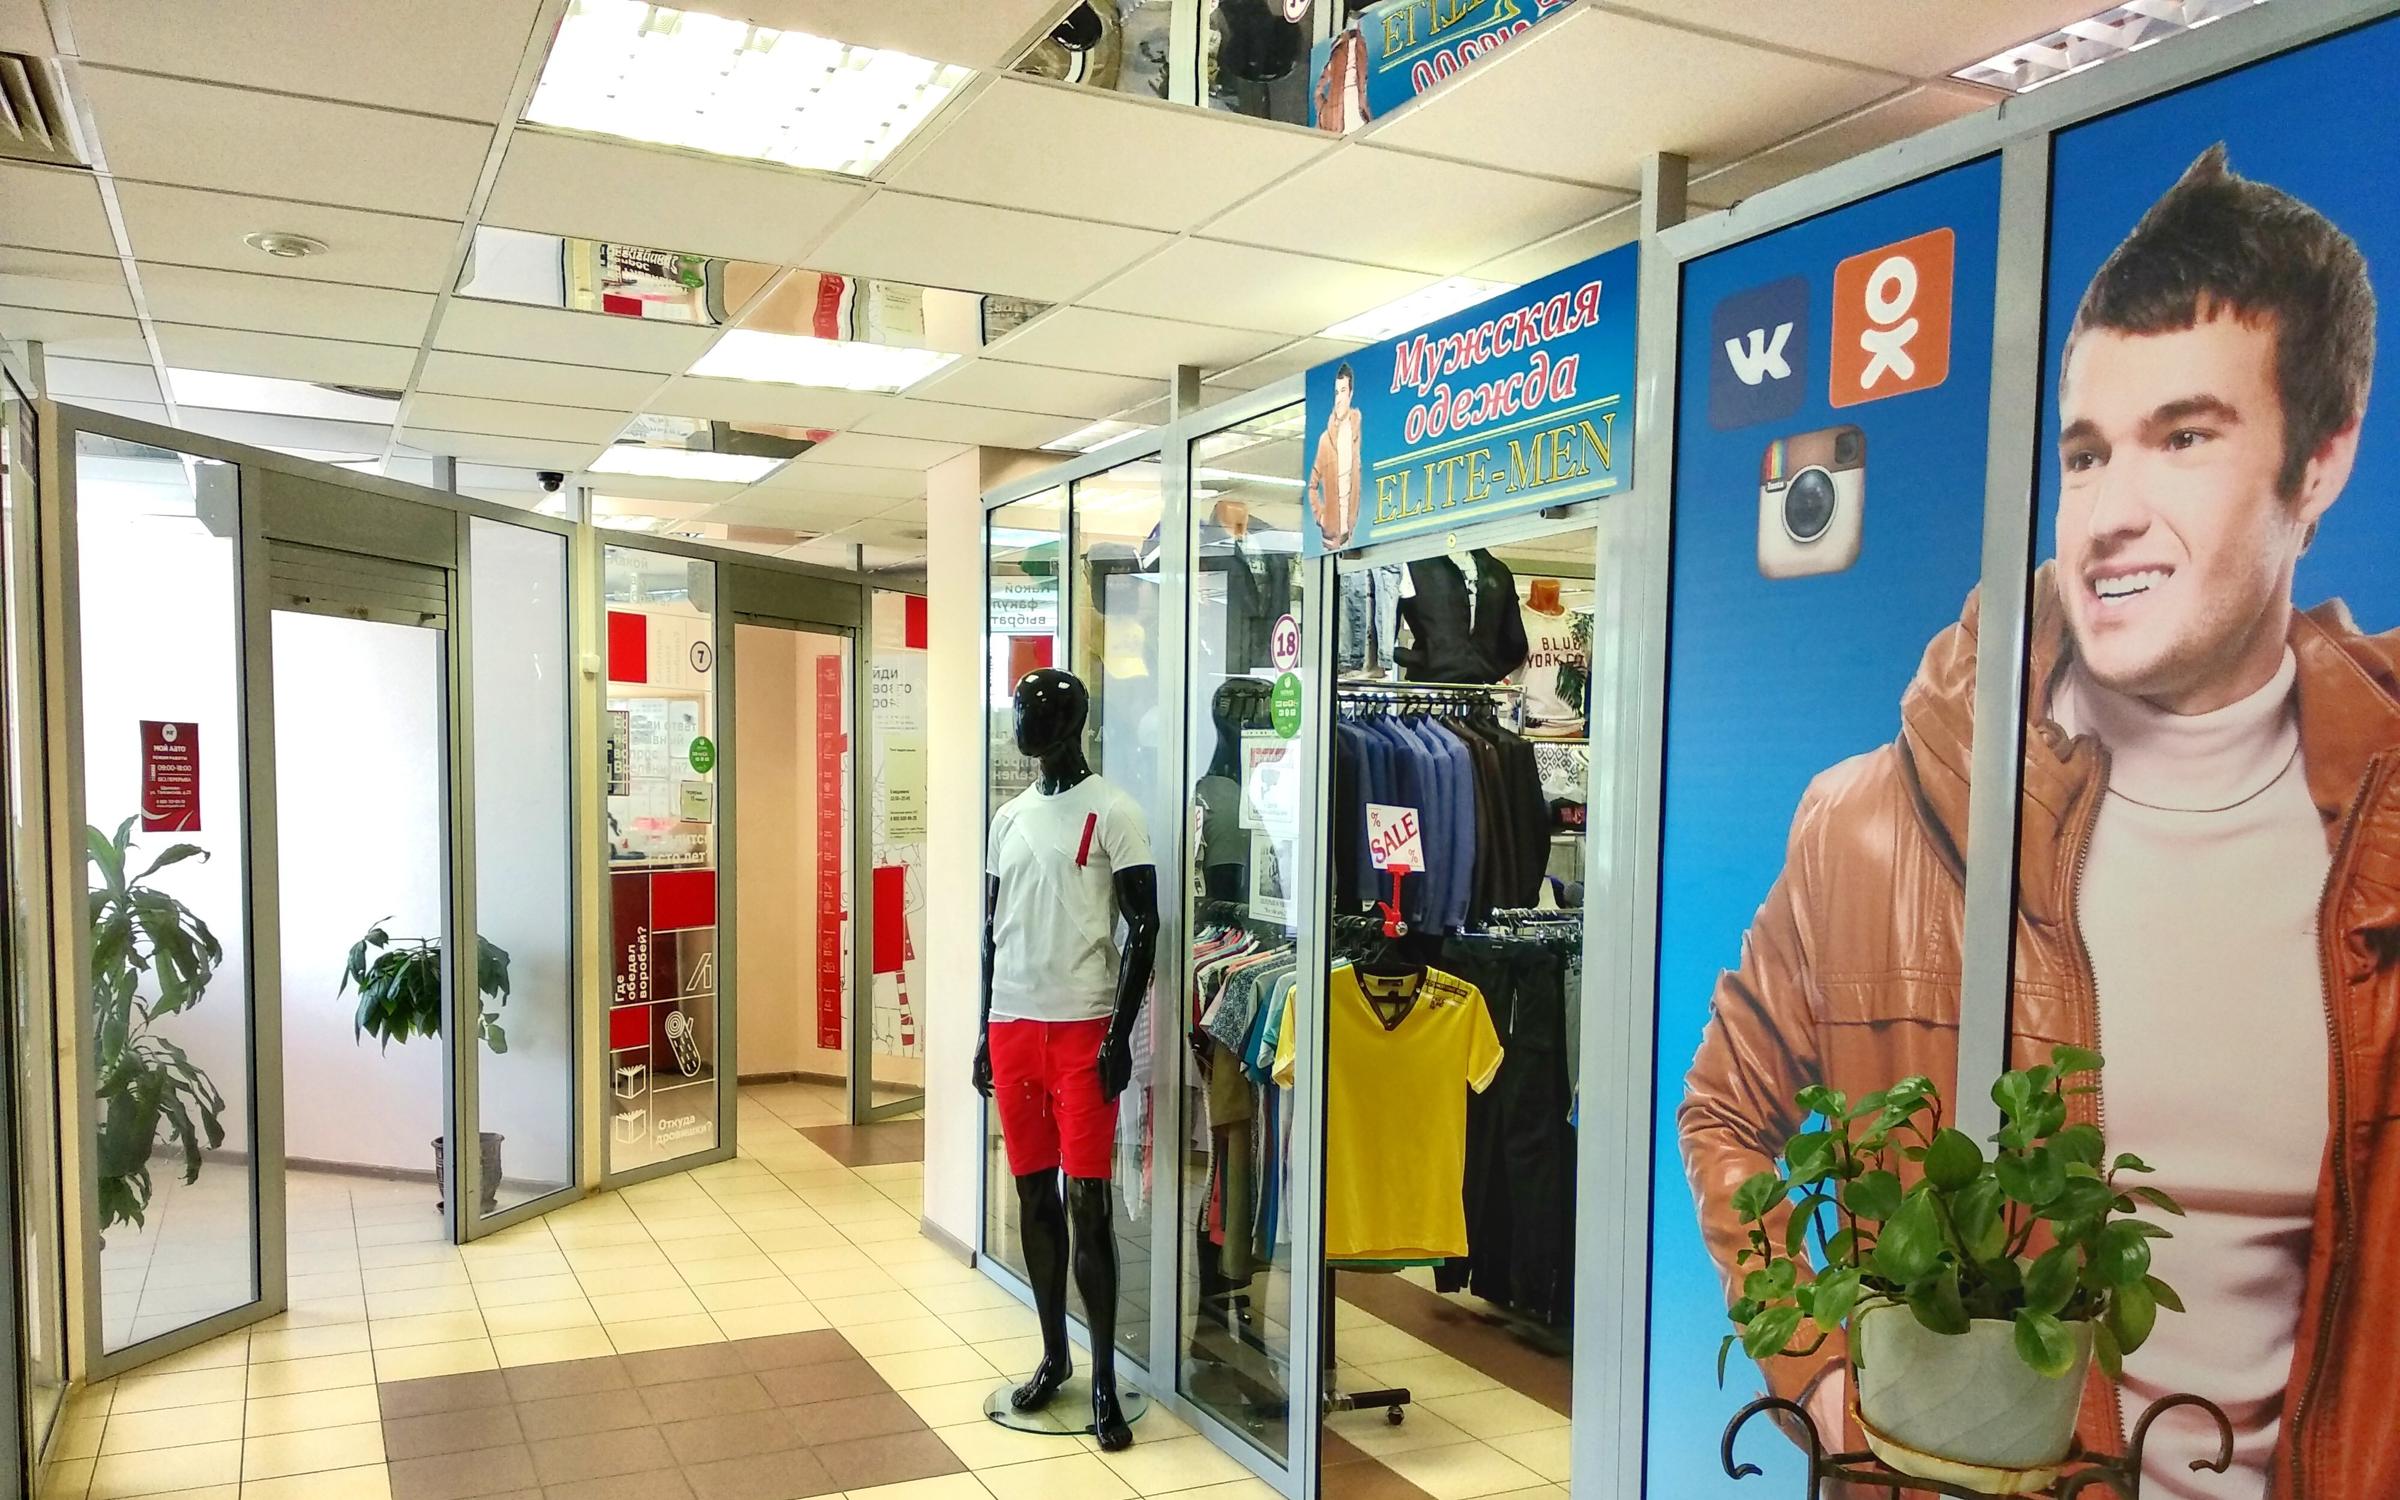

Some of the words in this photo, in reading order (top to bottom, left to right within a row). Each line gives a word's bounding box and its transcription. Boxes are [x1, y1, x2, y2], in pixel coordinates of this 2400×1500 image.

[1390, 280, 1603, 397] Мужская
[1404, 352, 1580, 444] одежда
[1372, 413, 1617, 526] ELITE-MEN
[697, 650, 705, 664] 7
[1276, 632, 1296, 657] 18
[1370, 811, 1418, 864] SALE
[615, 974, 626, 1002] Где
[627, 944, 638, 1001] обедал
[637, 926, 649, 999] воробей?
[658, 1115, 696, 1131] Откуда
